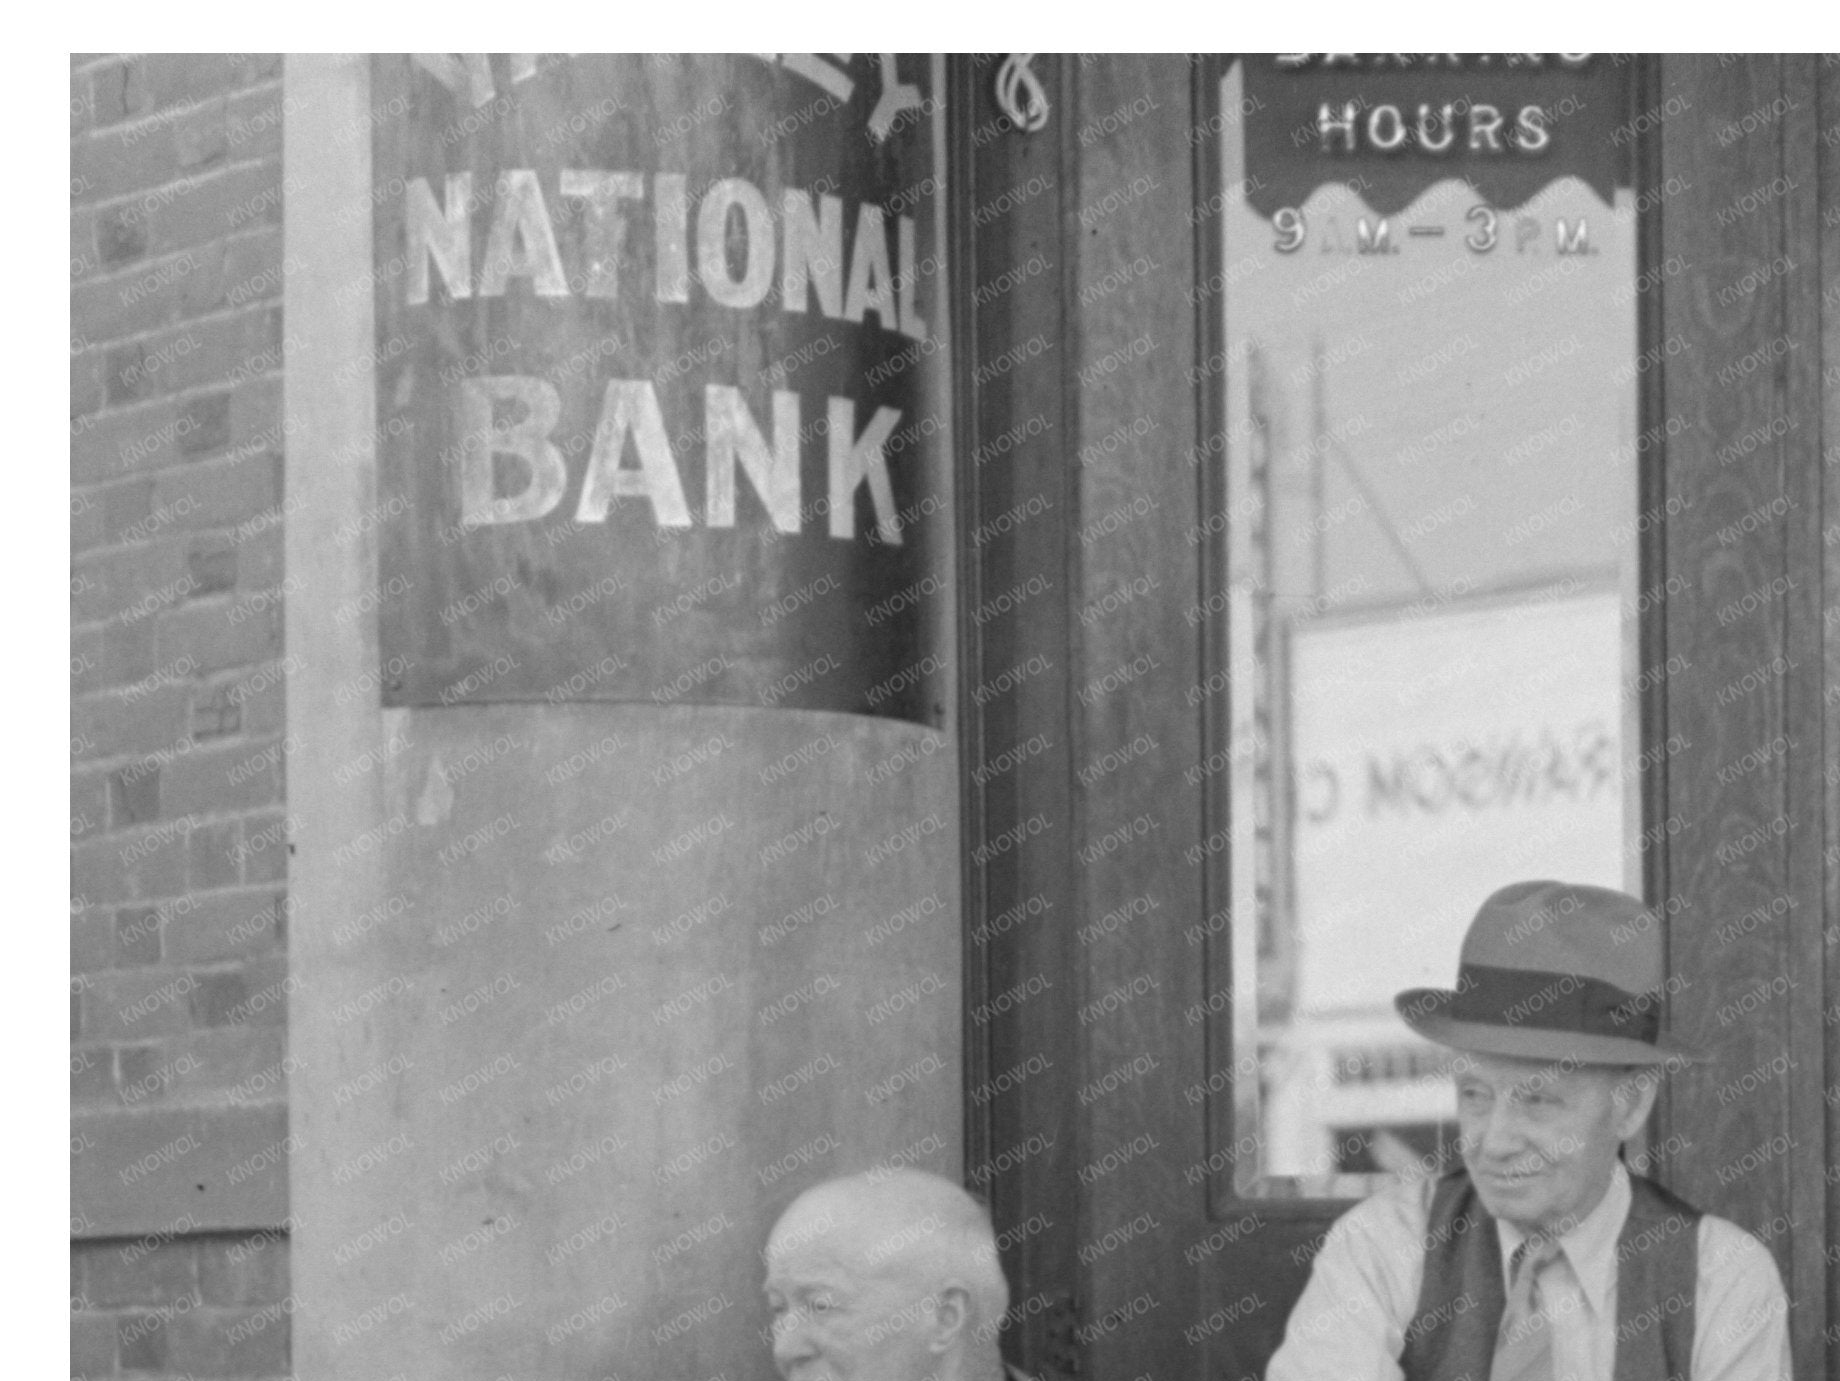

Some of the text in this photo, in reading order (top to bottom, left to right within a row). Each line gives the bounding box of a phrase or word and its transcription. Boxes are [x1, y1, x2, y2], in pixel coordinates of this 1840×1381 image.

[1318, 102, 1550, 150] HOURS
[404, 168, 929, 342] NATIONAL
[1272, 205, 1305, 253] 9
[1464, 203, 1498, 254] 3
[460, 375, 904, 547] BANK
